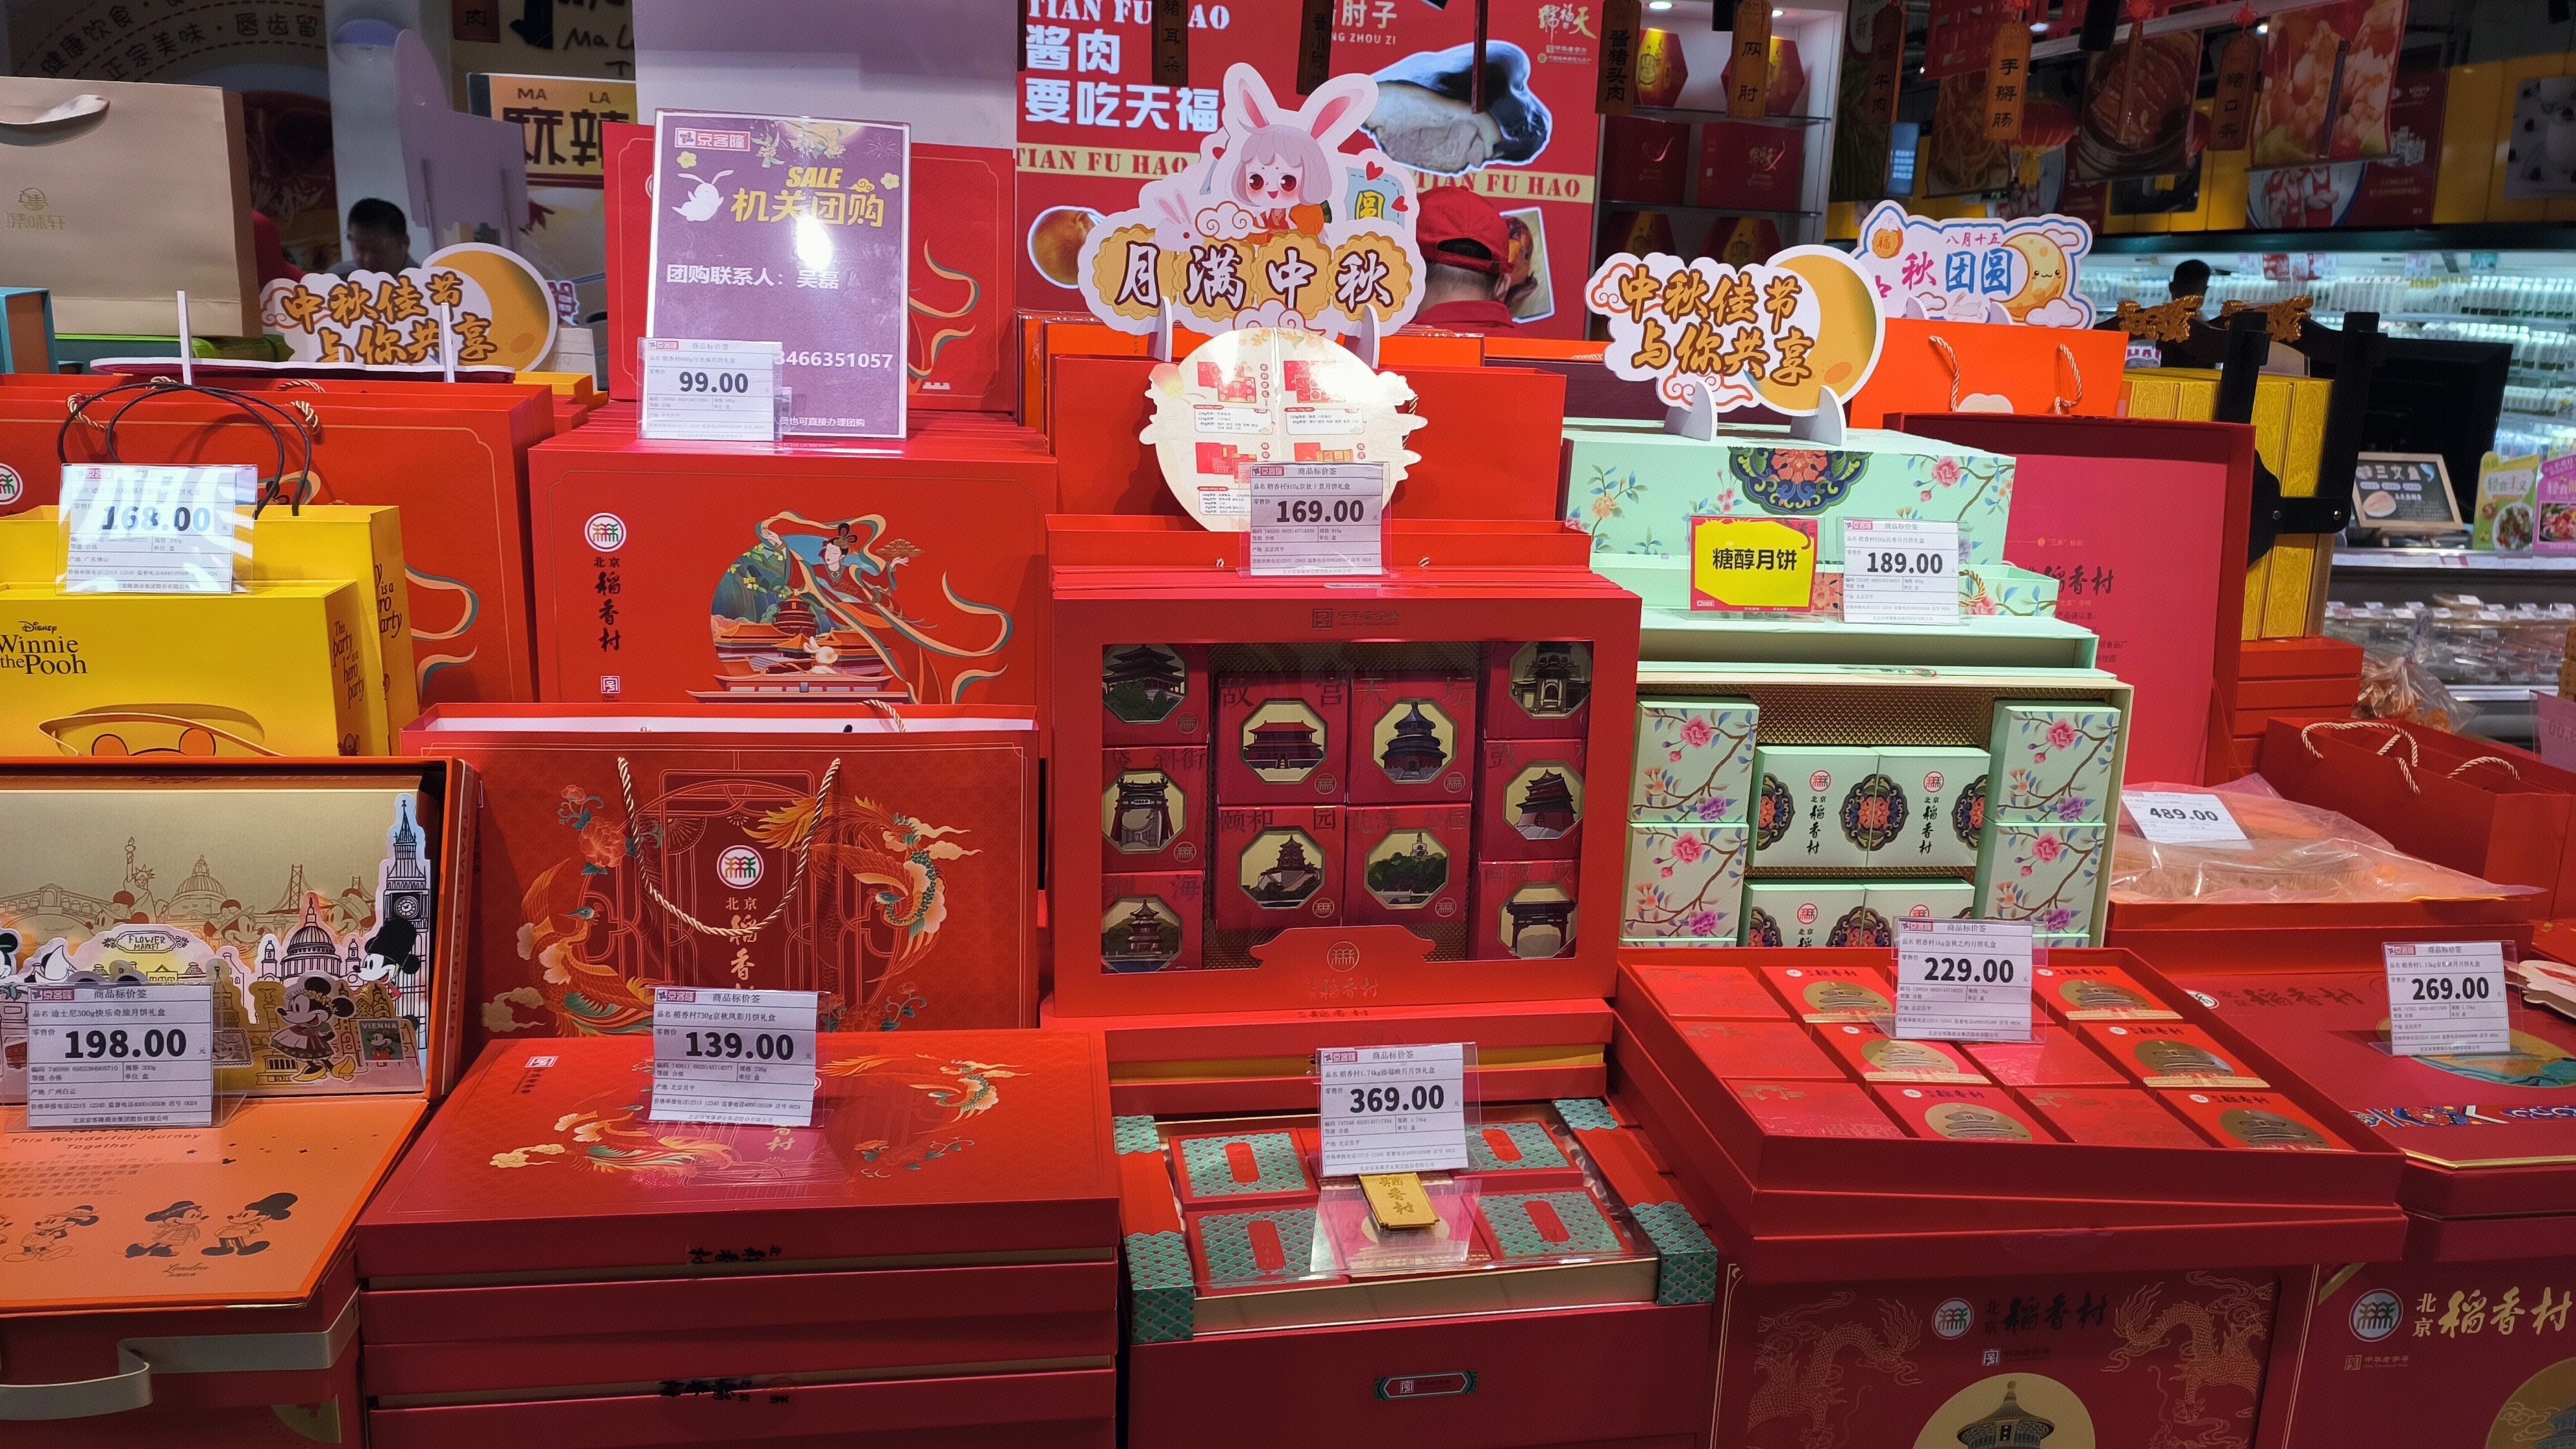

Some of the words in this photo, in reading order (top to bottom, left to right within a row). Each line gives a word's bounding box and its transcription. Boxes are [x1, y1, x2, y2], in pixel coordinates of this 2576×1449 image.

[465, 9, 488, 27] 肉
[1188, 5, 1230, 29] AO
[1332, 0, 1398, 29] 肘子
[1026, 25, 1120, 74] 酱肉
[1350, 33, 1381, 44] ZHOU
[1385, 35, 1396, 45] ZI
[1605, 29, 1630, 103] 酱猪头肉
[517, 88, 554, 101] MA
[589, 92, 610, 104] LA
[1026, 77, 1219, 132] 要吃天福
[697, 133, 744, 149] 京客隆
[1087, 152, 1121, 172] FU
[1132, 155, 1188, 175] HAO
[786, 167, 843, 188] SALE
[1487, 175, 1521, 195] FU
[1530, 176, 1581, 198] HAO
[730, 187, 884, 227] 机关团购
[1877, 236, 1890, 249] 福
[1946, 232, 2001, 247] 八月十五
[1117, 241, 1393, 308] 月满中秋
[281, 271, 463, 334] 中秋佳节
[1619, 264, 1802, 331] 中秋佳节
[1633, 319, 1814, 386] 与你共享
[679, 371, 748, 393] 99.00
[774, 416, 865, 427] 员也可直接办理团购
[102, 506, 210, 531] 168.00
[1276, 500, 1364, 523] 169.00
[593, 556, 620, 568] 北京
[1713, 547, 1797, 571] 糖醇月饼
[1867, 552, 1943, 574] 189.00
[595, 571, 621, 652] 稻香村
[378, 610, 402, 638] arty
[0, 634, 79, 653] Winnie
[333, 631, 353, 668] party
[0, 654, 25, 668] the
[23, 654, 88, 675] Pooh
[343, 658, 358, 684] hero
[2150, 808, 2218, 821] 489.00
[1806, 805, 1825, 854] 稻香村
[1918, 805, 1938, 854] 稻香村
[725, 897, 758, 910] 北京
[129, 935, 166, 944] FLOWER
[730, 914, 758, 989] 稻香
[1924, 957, 2014, 983] 229.00
[94, 989, 147, 999] 商品标价签
[712, 993, 761, 1003] 商品标价签
[2412, 977, 2489, 1000] 269.00
[65, 1029, 186, 1058] 198.00
[686, 1032, 794, 1060] 139.00
[1372, 1050, 1413, 1059] 商品标价签
[1350, 1085, 1444, 1113] 369.00
[162, 1263, 210, 1273] London
[1985, 1300, 2000, 1335] 北京
[2003, 1292, 2108, 1334] 稻香村
[2412, 1293, 2436, 1337] 北京
[2438, 1286, 2573, 1338] 稻香村
